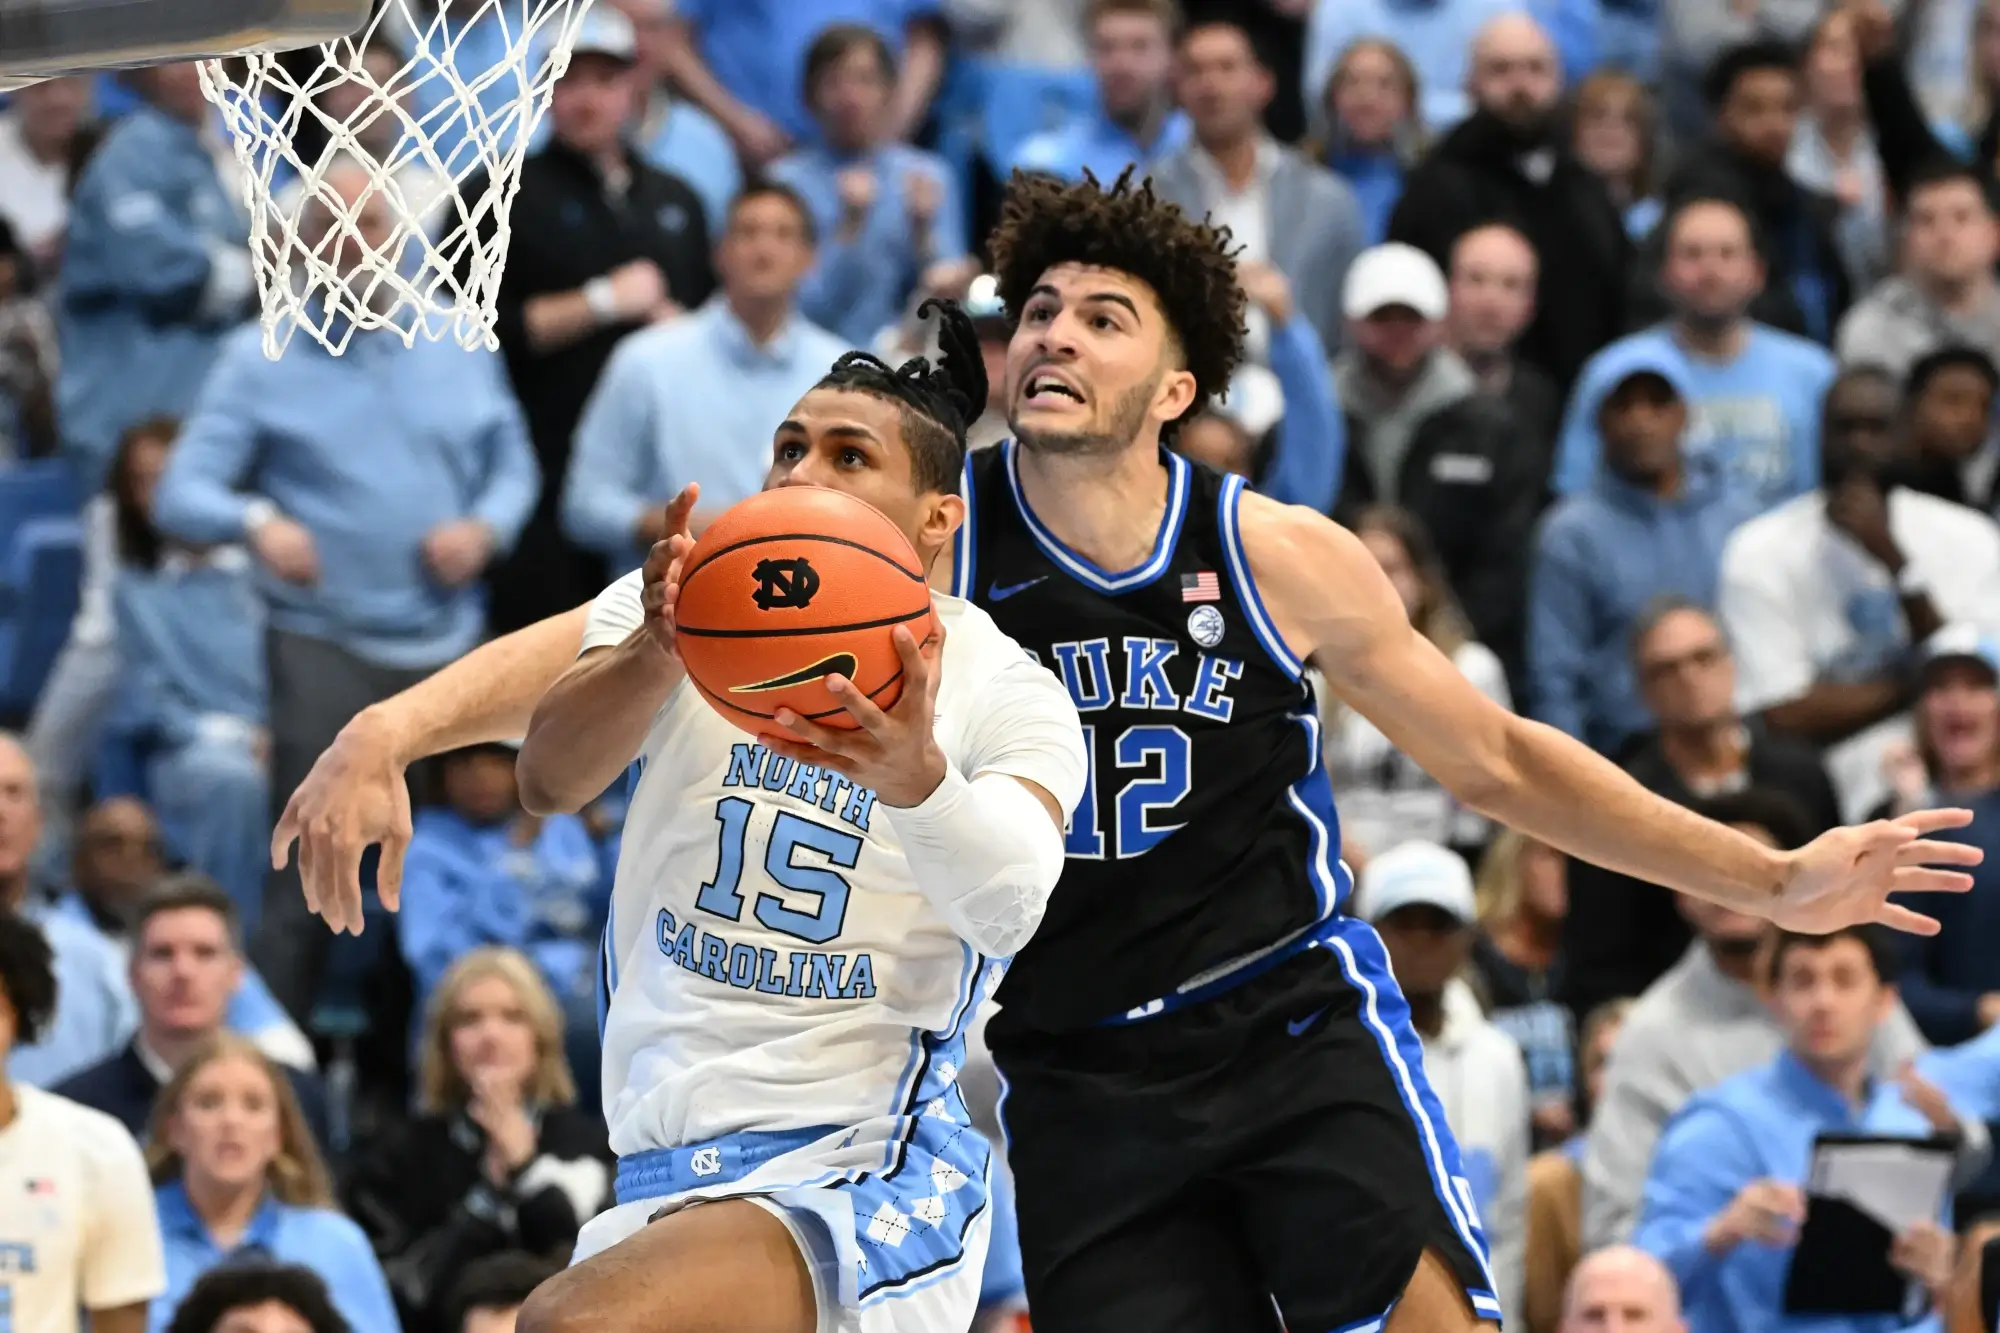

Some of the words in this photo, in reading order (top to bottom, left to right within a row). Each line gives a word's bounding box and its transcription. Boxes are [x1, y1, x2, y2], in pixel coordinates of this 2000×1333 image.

[1023, 636, 1244, 723] UKE
[722, 743, 877, 833] NORTH
[695, 795, 864, 945] 15
[656, 907, 877, 999] CAROLINA
